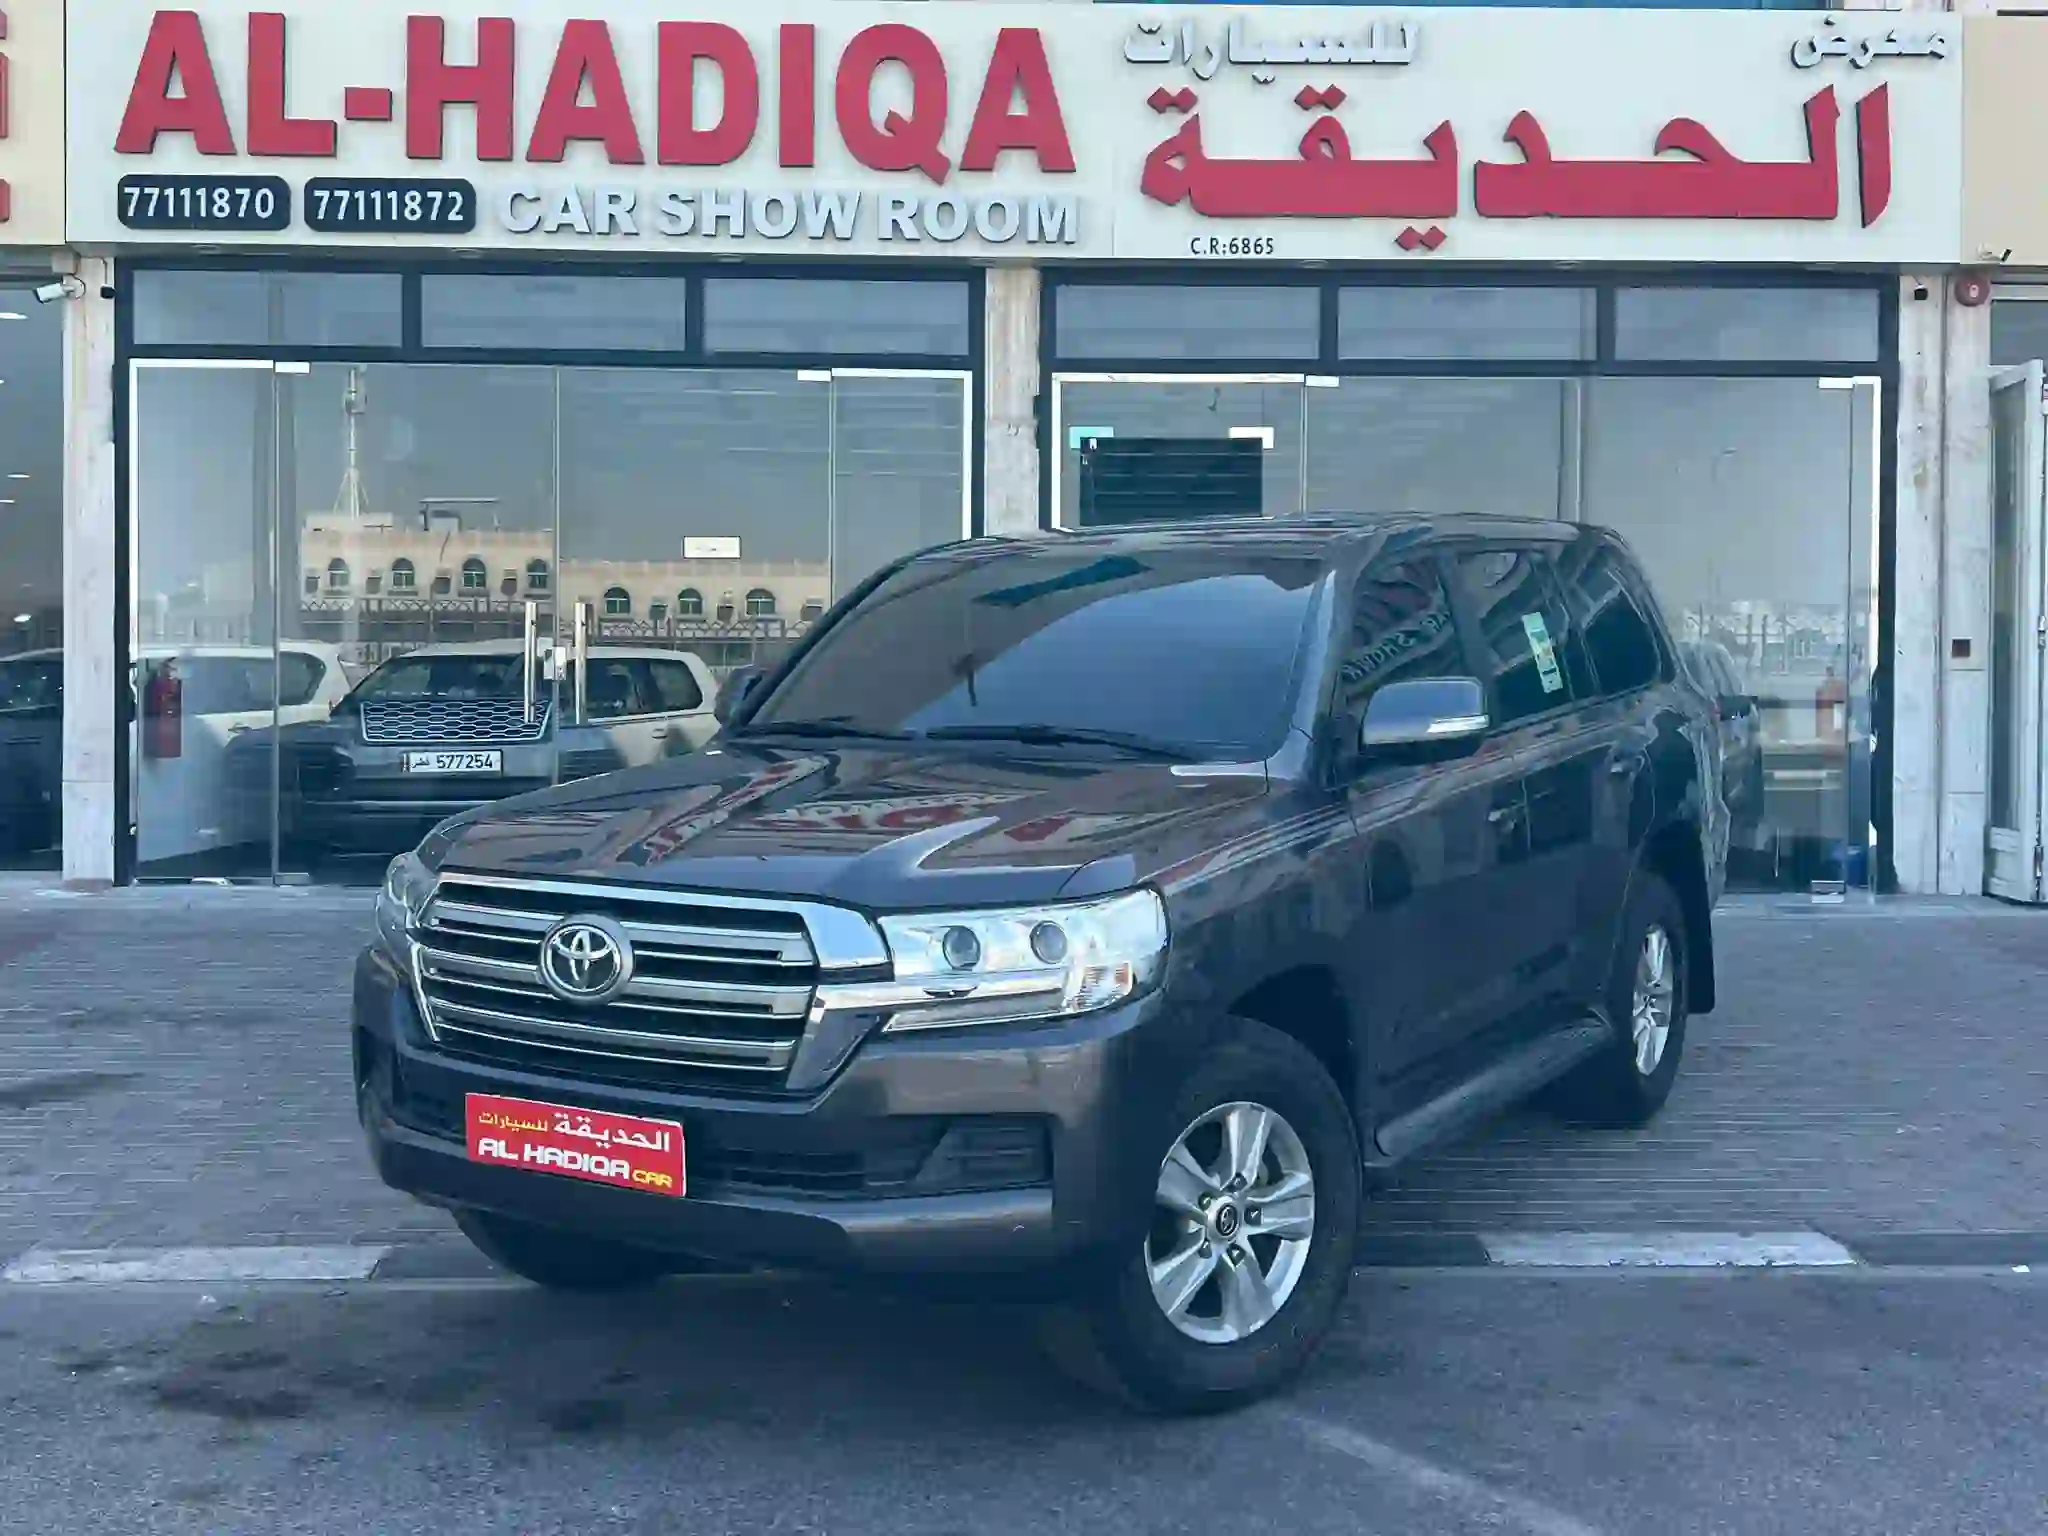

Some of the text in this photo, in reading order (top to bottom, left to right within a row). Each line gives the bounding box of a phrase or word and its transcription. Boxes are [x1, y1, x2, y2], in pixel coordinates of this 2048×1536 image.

[1123, 17, 1420, 83] للسيارات
[1790, 14, 1947, 69] معرض
[115, 10, 1076, 186] AL-HADIQA
[1141, 83, 1892, 251] الحديقة
[123, 187, 464, 222] 77111870 77111872
[501, 187, 1077, 245] CAR SHOW ROOM
[1190, 236, 1275, 256] C.R:6865
[436, 753, 493, 769] 577254
[478, 1112, 669, 1152] الحديقة للسيارات
[477, 1137, 673, 1188] AL HADIQA CAR
